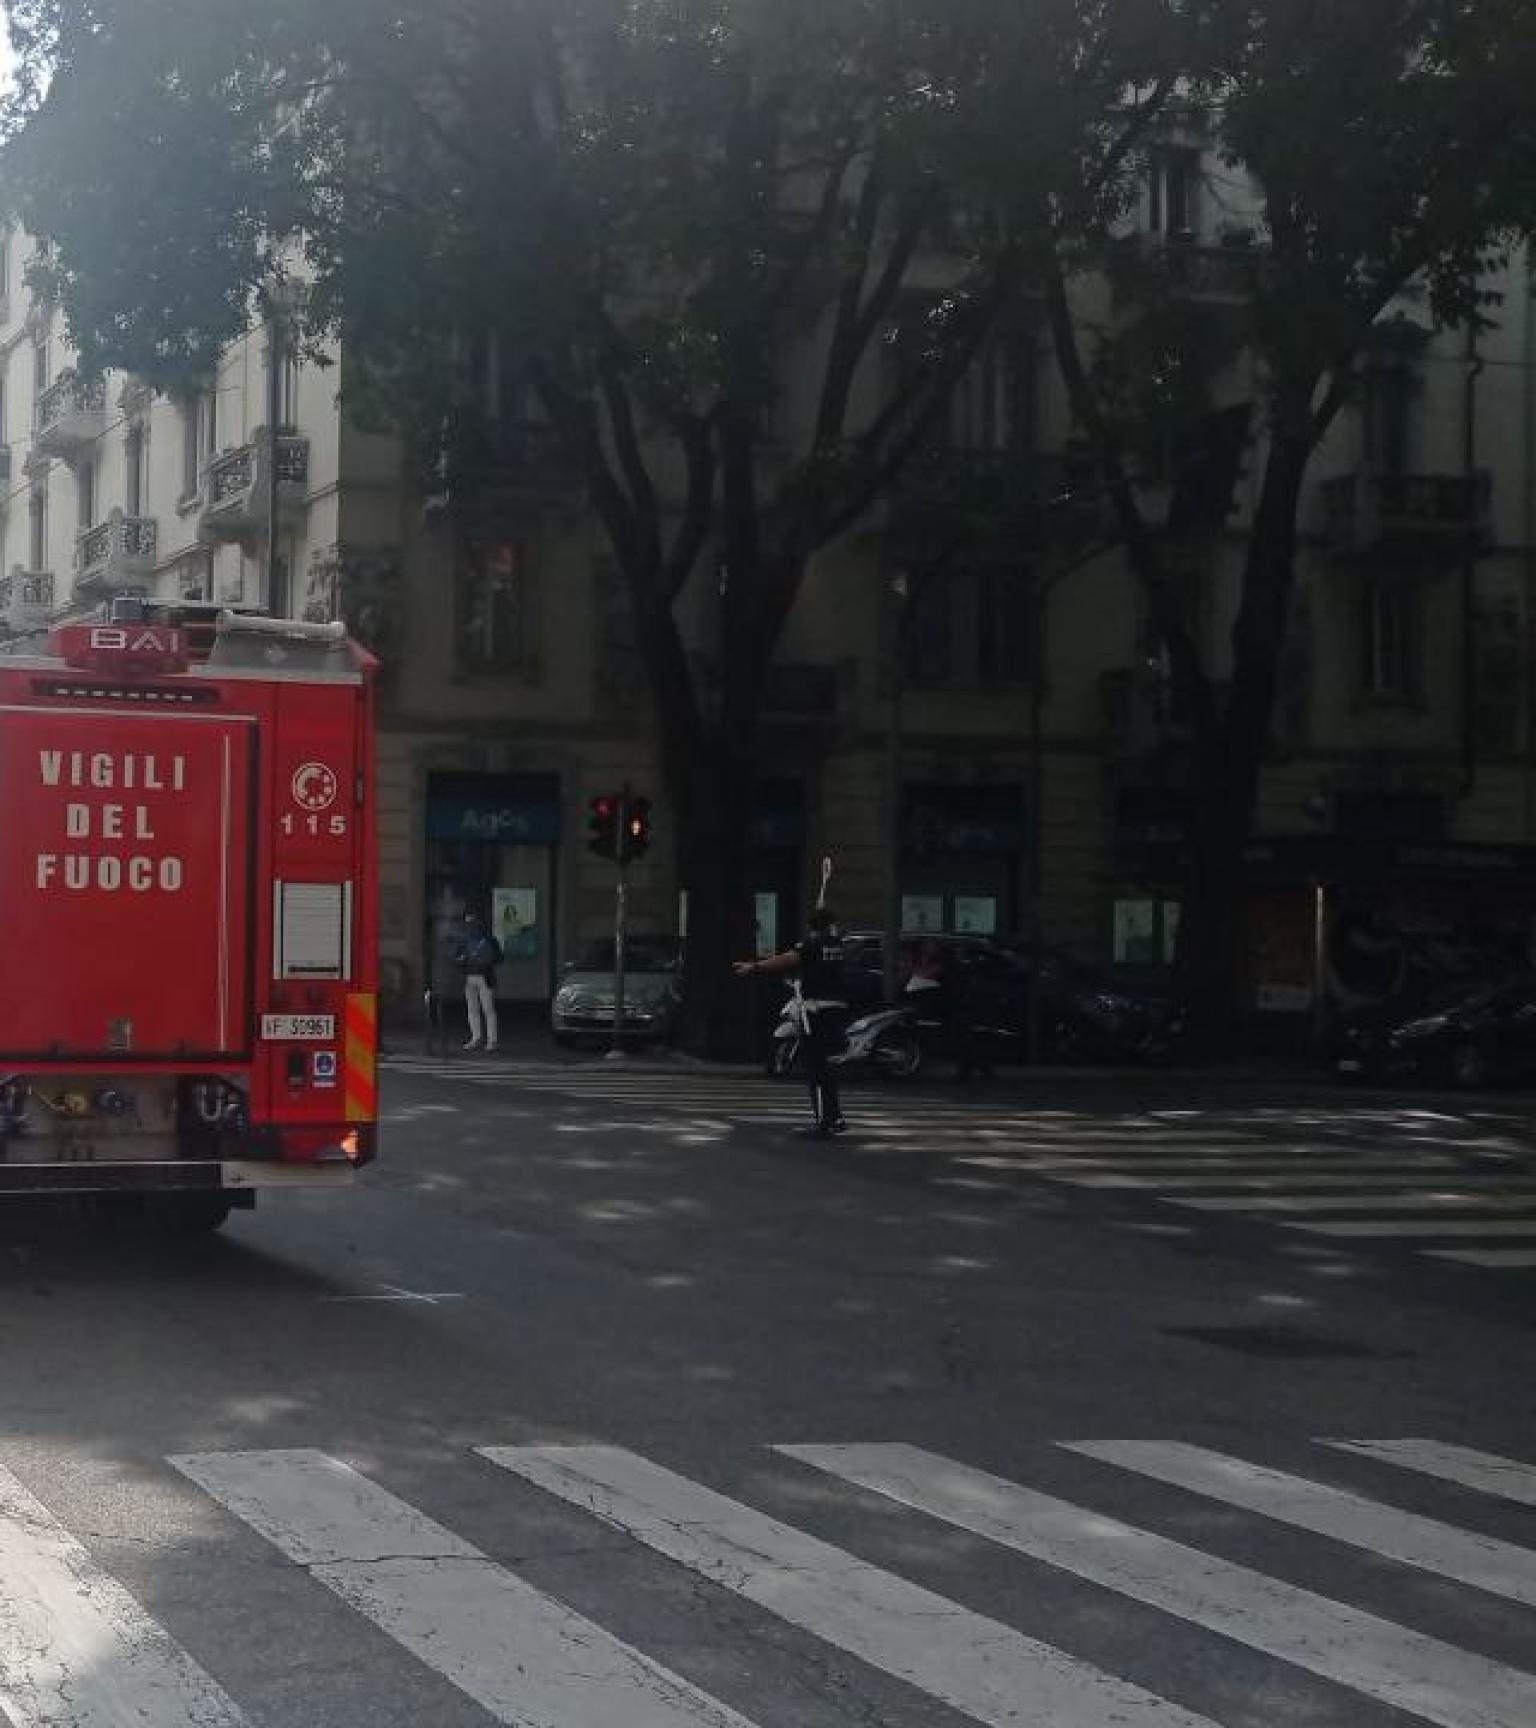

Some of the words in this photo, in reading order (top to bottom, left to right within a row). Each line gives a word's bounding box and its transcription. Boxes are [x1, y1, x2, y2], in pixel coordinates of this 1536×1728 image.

[90, 628, 179, 654] BAI
[40, 750, 184, 790] VIGILI
[66, 803, 155, 840] DEL
[37, 853, 182, 891] FUOCO
